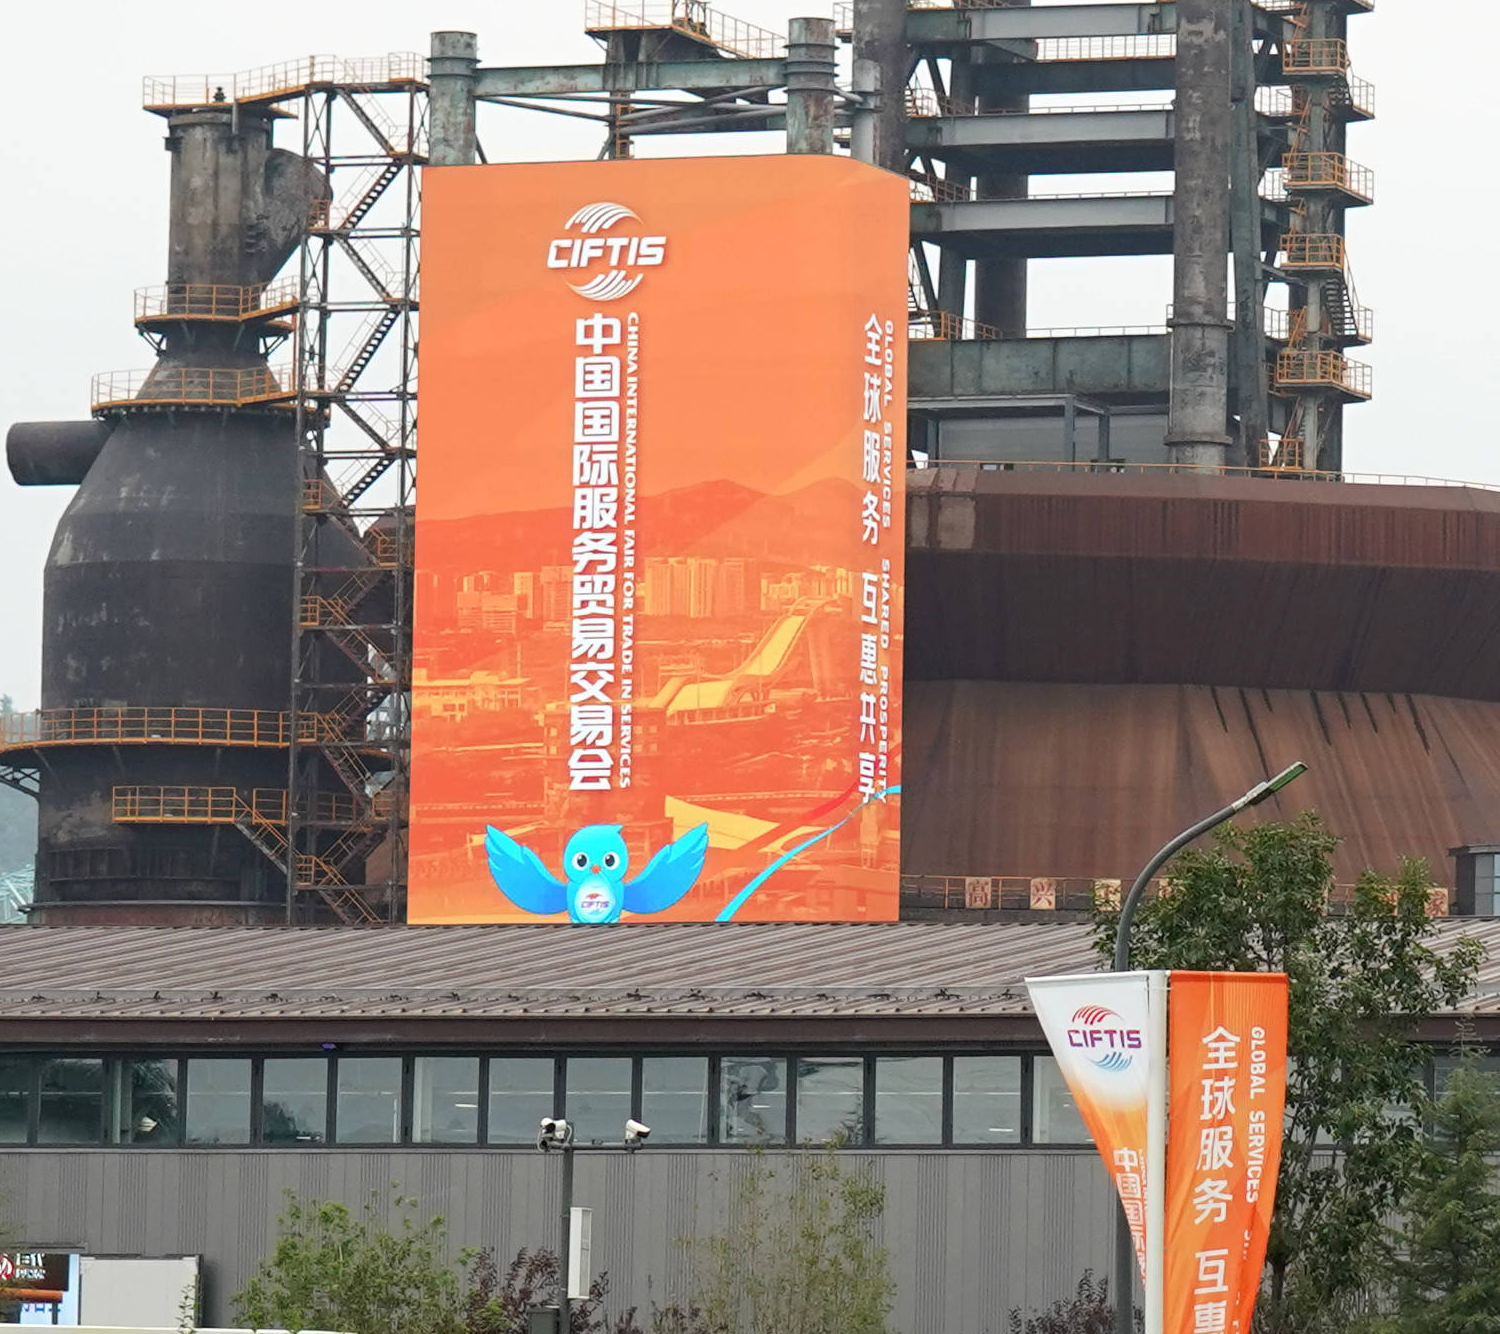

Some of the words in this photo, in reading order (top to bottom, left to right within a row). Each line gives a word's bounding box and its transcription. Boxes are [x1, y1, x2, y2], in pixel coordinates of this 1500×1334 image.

[547, 235, 667, 269] CIFTIS
[626, 312, 639, 373] CHINA
[883, 320, 894, 407] GLOBAL
[624, 375, 638, 524] INTERNATIONAL
[861, 313, 883, 545] 全球服务
[882, 421, 892, 528] SERVICES
[568, 312, 622, 791] 中国国际服务贸易交易会
[622, 571, 635, 609] FOR
[623, 529, 636, 568] FAIR
[621, 614, 634, 674] TRADE
[879, 558, 890, 649] SHARED
[621, 683, 632, 699] IN
[858, 571, 878, 804] 互惠共享
[619, 703, 632, 788] SERVICES
[878, 665, 889, 804] PROSPERITY
[1067, 1029, 1143, 1049] CIFTIS
[1249, 1026, 1266, 1099] GLOBAL
[1192, 1026, 1241, 1225] 全球服务
[1246, 1110, 1266, 1203] SERVICES
